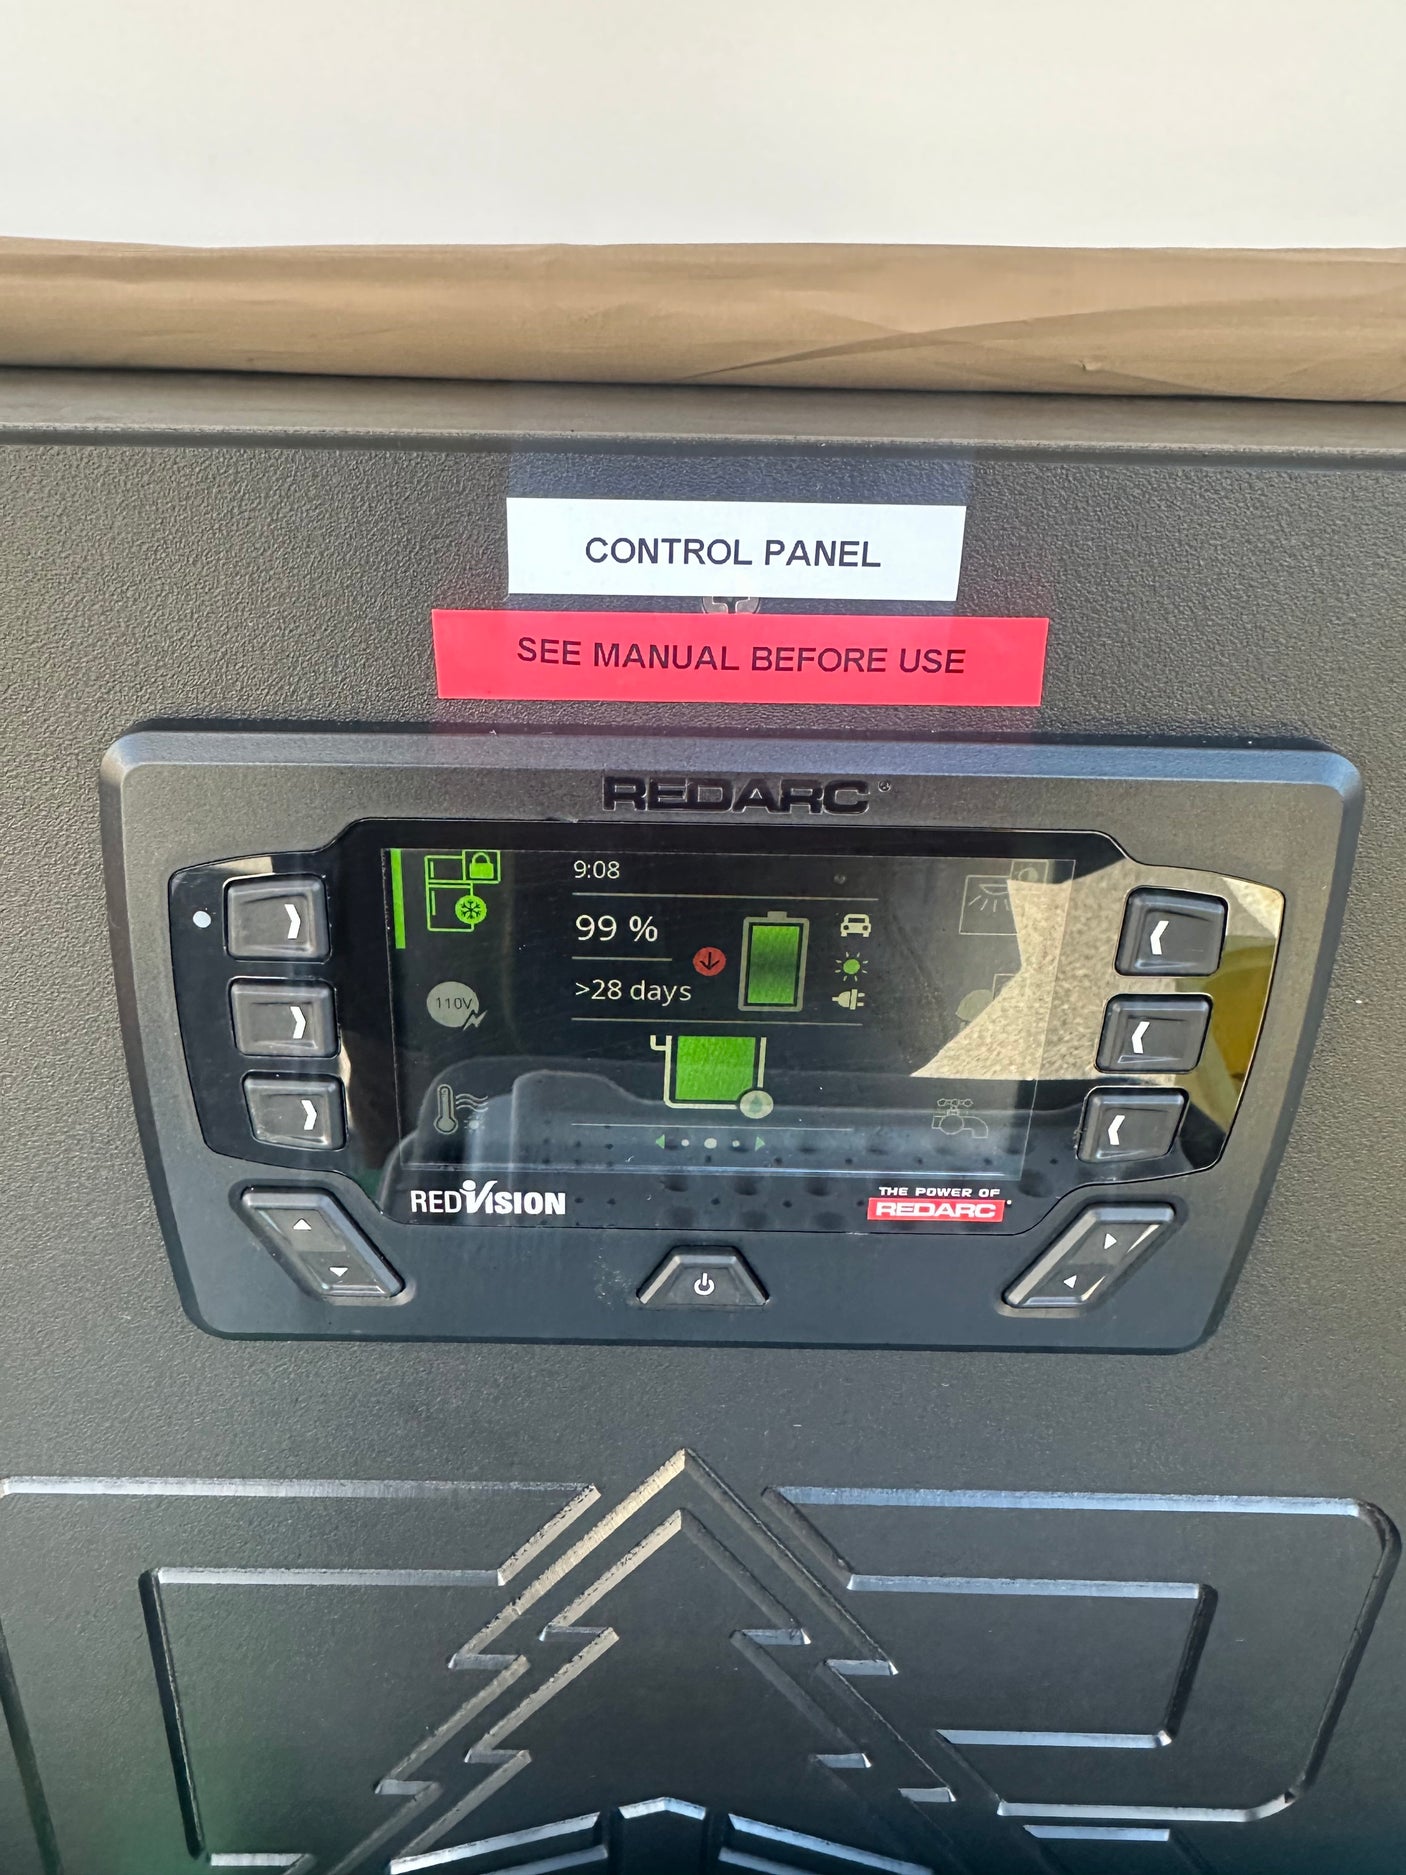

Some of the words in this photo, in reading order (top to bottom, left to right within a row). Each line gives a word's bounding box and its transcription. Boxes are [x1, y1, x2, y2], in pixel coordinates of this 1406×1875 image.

[585, 537, 752, 566] CONTROL
[764, 539, 881, 568] PANEL
[516, 637, 582, 667] SEE
[593, 642, 739, 671] MANUAL
[751, 646, 887, 674] BEFORE
[899, 649, 966, 675] USE
[573, 860, 620, 879] 9:08
[575, 915, 617, 941] 99
[629, 916, 659, 942] %
[435, 997, 473, 1010] 110V
[575, 980, 622, 1000] >28
[630, 980, 692, 1006] days
[878, 1186, 909, 1196] THE
[915, 1187, 972, 1197] POWER
[978, 1188, 1001, 1198] OF
[875, 1202, 996, 1218] REDARC
